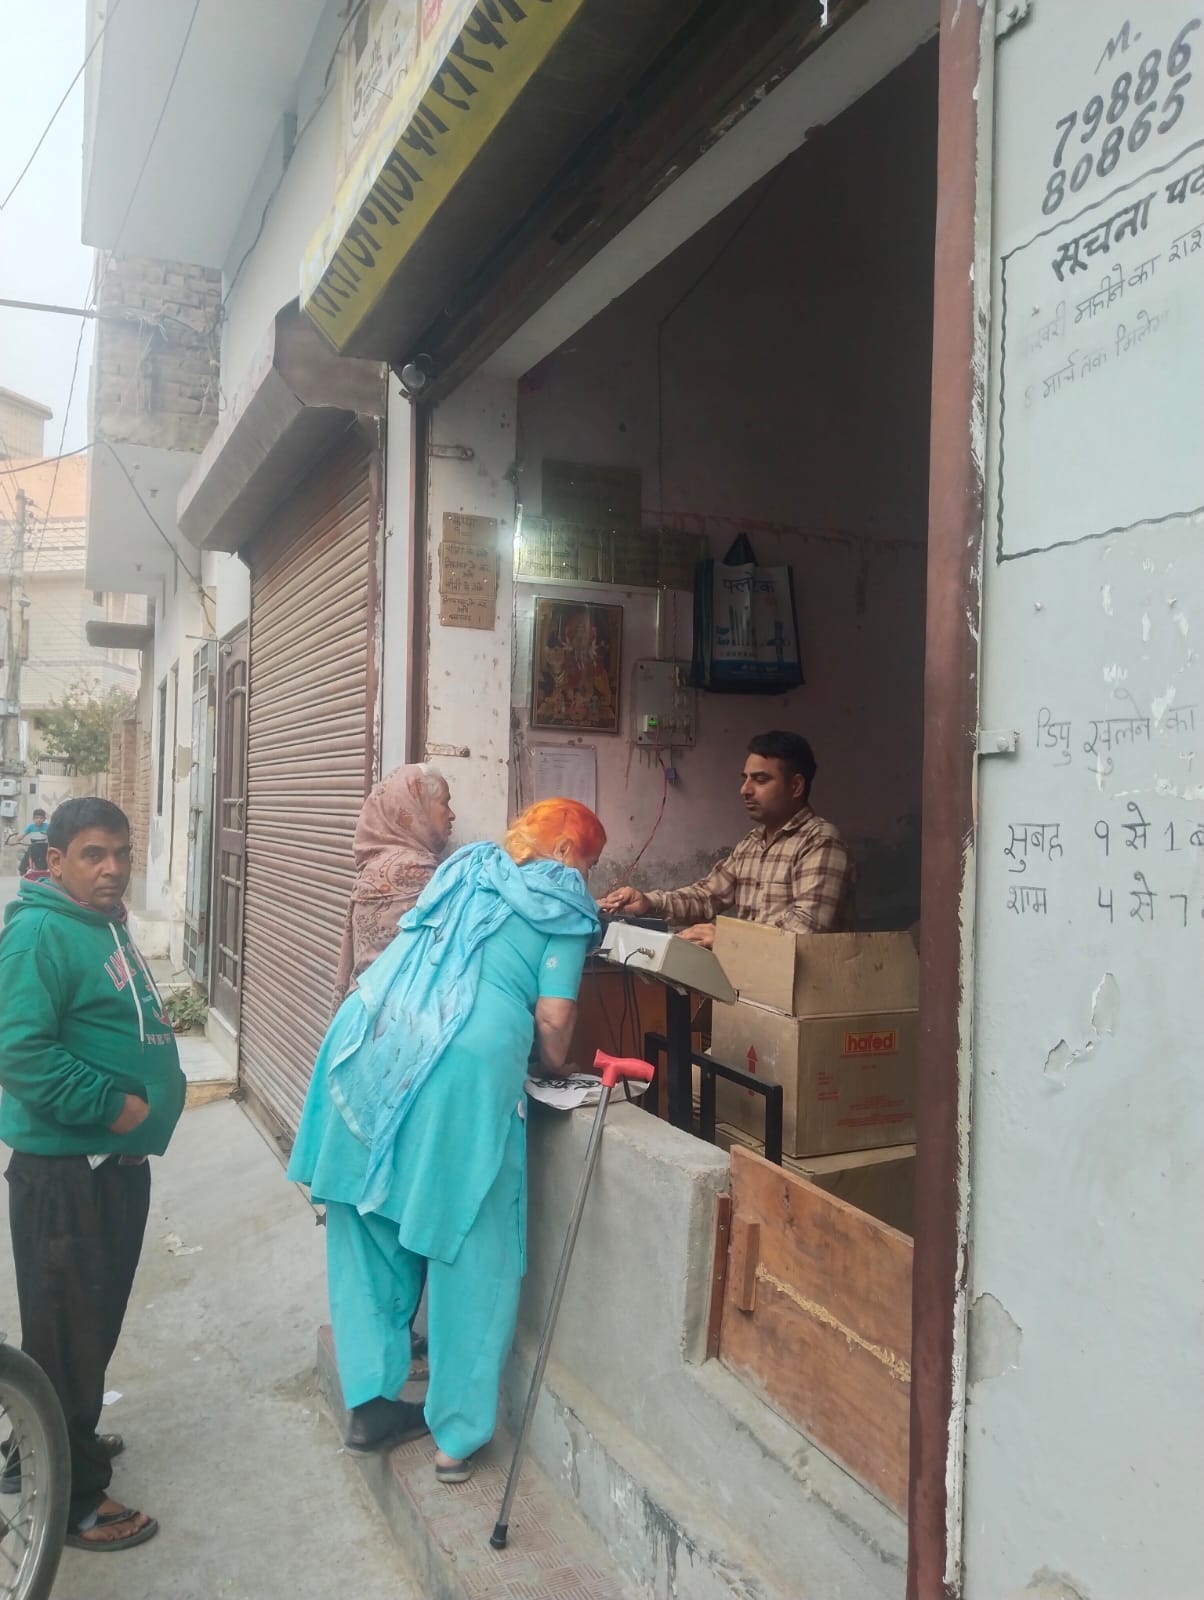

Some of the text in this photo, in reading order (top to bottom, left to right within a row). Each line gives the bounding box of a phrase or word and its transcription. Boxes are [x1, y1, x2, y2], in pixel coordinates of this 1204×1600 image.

[1052, 18, 1201, 169] 79886
[1042, 72, 1192, 216] 80865
[1052, 191, 1158, 282] सूचना
[1003, 823, 1063, 873] सुबह
[1121, 801, 1151, 850] से
[1163, 821, 1183, 852] 1
[1007, 886, 1047, 915] शाम
[1097, 886, 1113, 923] 4
[1129, 871, 1158, 922] से
[1169, 894, 1188, 928] 7
[847, 1032, 893, 1052] hafed
